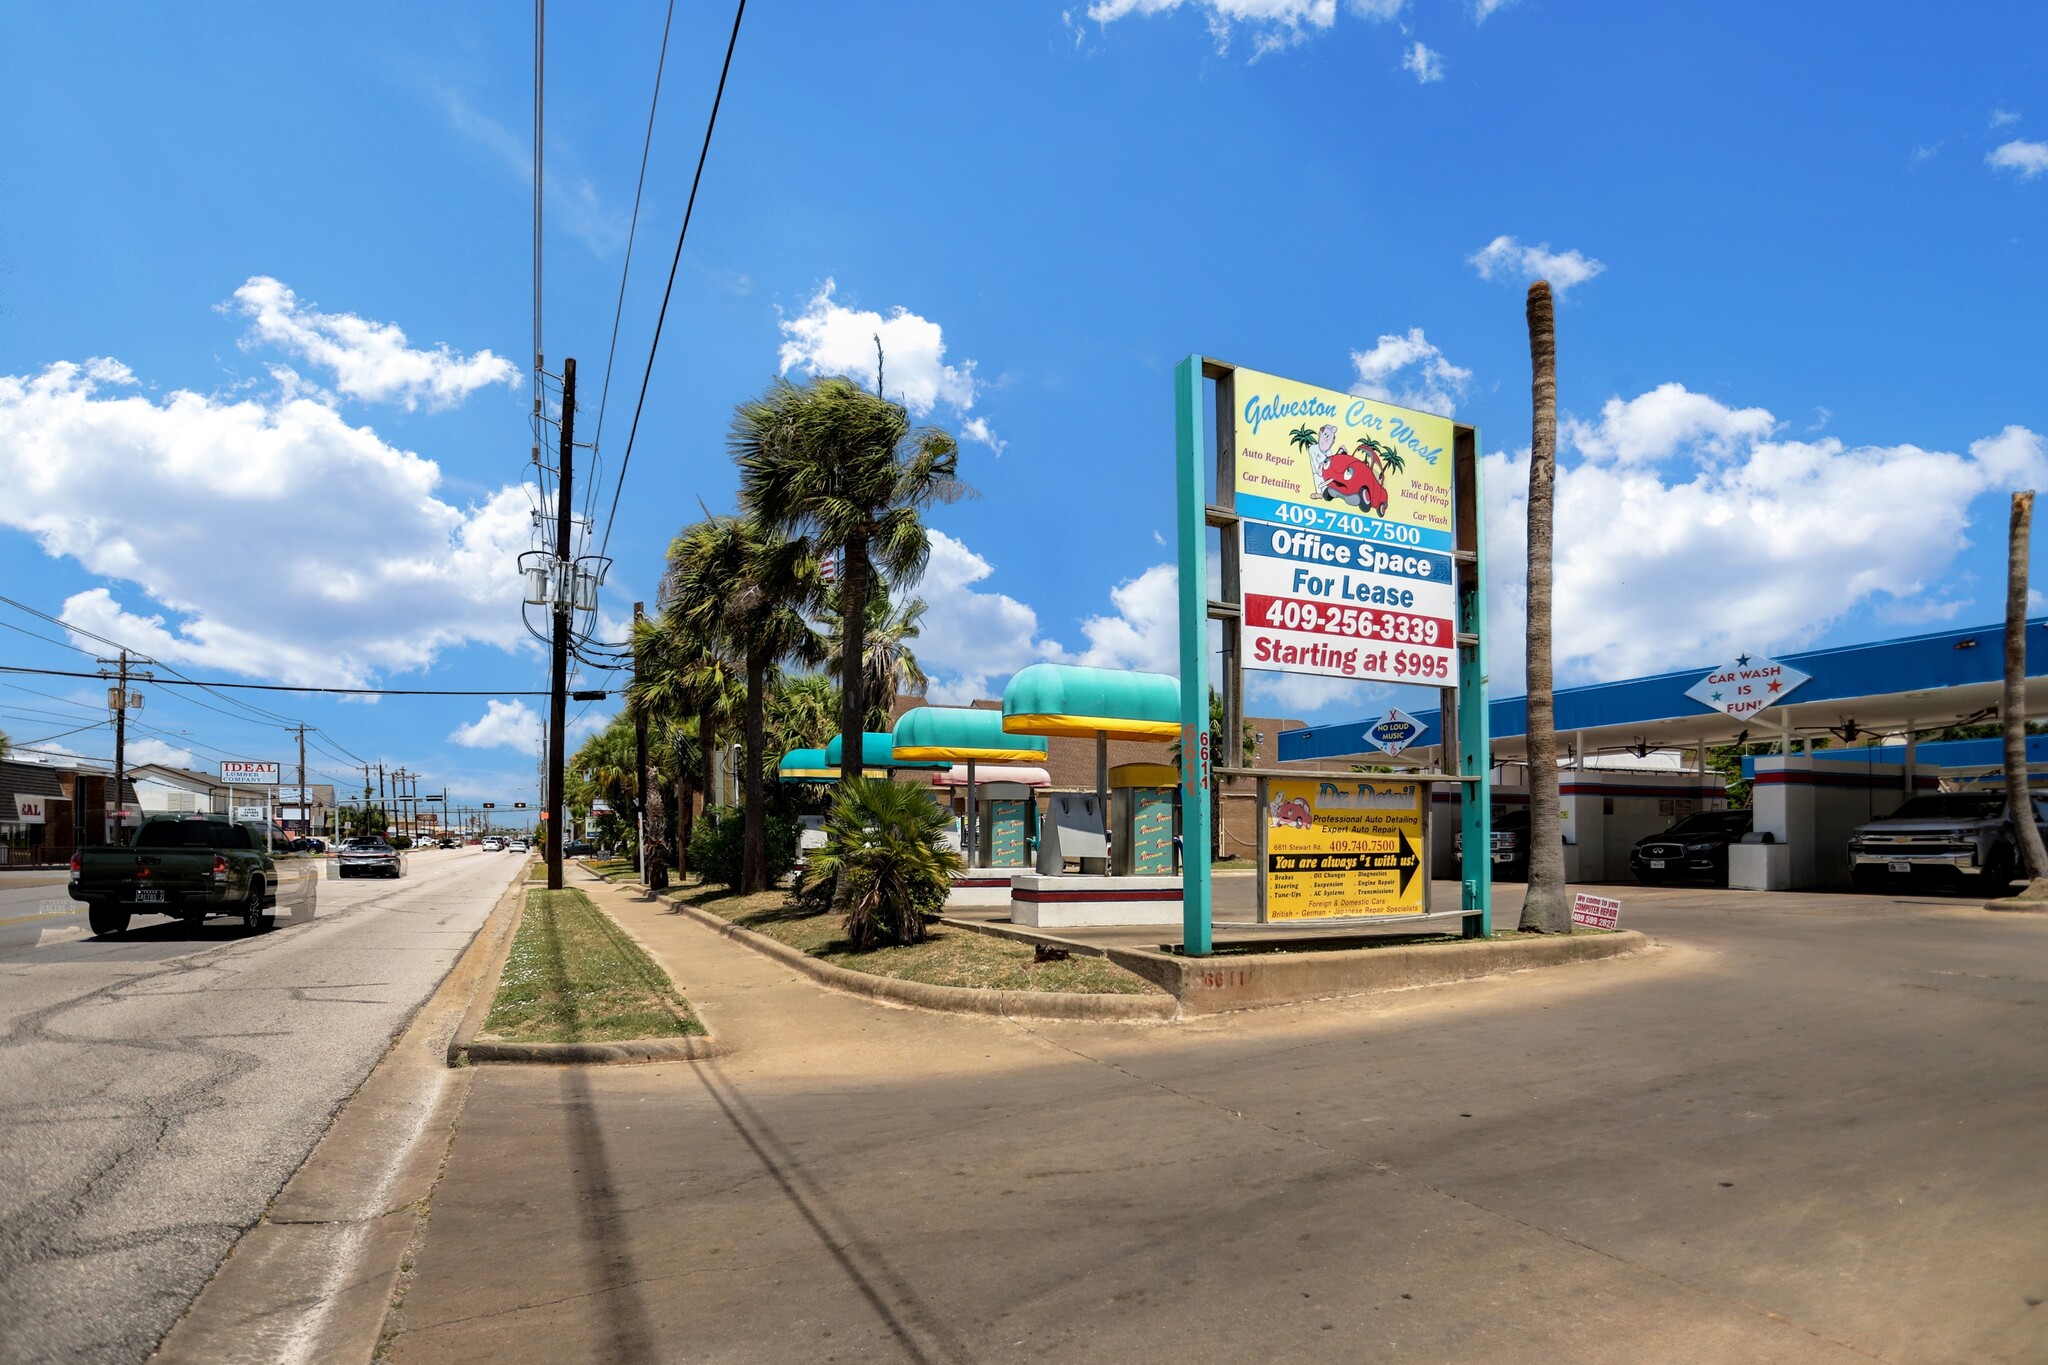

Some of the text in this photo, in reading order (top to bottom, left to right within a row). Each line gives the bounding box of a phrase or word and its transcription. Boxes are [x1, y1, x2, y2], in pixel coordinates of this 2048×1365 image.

[1244, 394, 1443, 465] Galveston Car Wash
[1242, 447, 1295, 467] Auto Repair
[1242, 471, 1301, 493] Car Detailing
[1411, 480, 1449, 496] We Do Any
[1400, 489, 1449, 509] Kind of Wrap
[1274, 503, 1421, 545] 409-740-7500
[1412, 511, 1448, 526] Car Wash
[1271, 529, 1432, 577] Office Space
[1292, 567, 1414, 608] For Lease
[1265, 599, 1438, 645] 409-256-3339
[1253, 636, 1449, 679] Starting at $995
[1708, 666, 1781, 685] CAR WASH
[1737, 685, 1752, 696] IS
[1726, 699, 1762, 713] FUN!
[1377, 723, 1409, 732] NO LOUD
[1382, 732, 1405, 740] MUSIC
[224, 763, 276, 773] IDEAL
[1183, 723, 1197, 798] 6611
[1200, 731, 1209, 790] 6611
[1319, 782, 1416, 809] Dr. Detail
[1313, 814, 1418, 825] Professional Auto Detailing
[1322, 825, 1397, 835] Expert Auto Repair
[1329, 840, 1395, 852] 409.740.7500
[1275, 855, 1296, 870] You
[1298, 858, 1318, 869] are
[1320, 855, 1357, 870] always
[1374, 854, 1397, 867] with
[1400, 854, 1416, 867] us!
[1324, 872, 1346, 880] Changes
[1357, 879, 1395, 888] Engine Repair
[1313, 881, 1344, 889] Suspension
[1357, 888, 1394, 896] Transmissions
[1274, 891, 1302, 899] Tune-Ups
[1323, 889, 1345, 897] Systems
[1308, 900, 1332, 908] Foreign
[1340, 898, 1369, 907] Domestic
[1371, 897, 1386, 905] Cars
[1271, 904, 1418, 918] British German Japanese Repair Specialists
[1575, 903, 1618, 918] COMPUTER REPAIR
